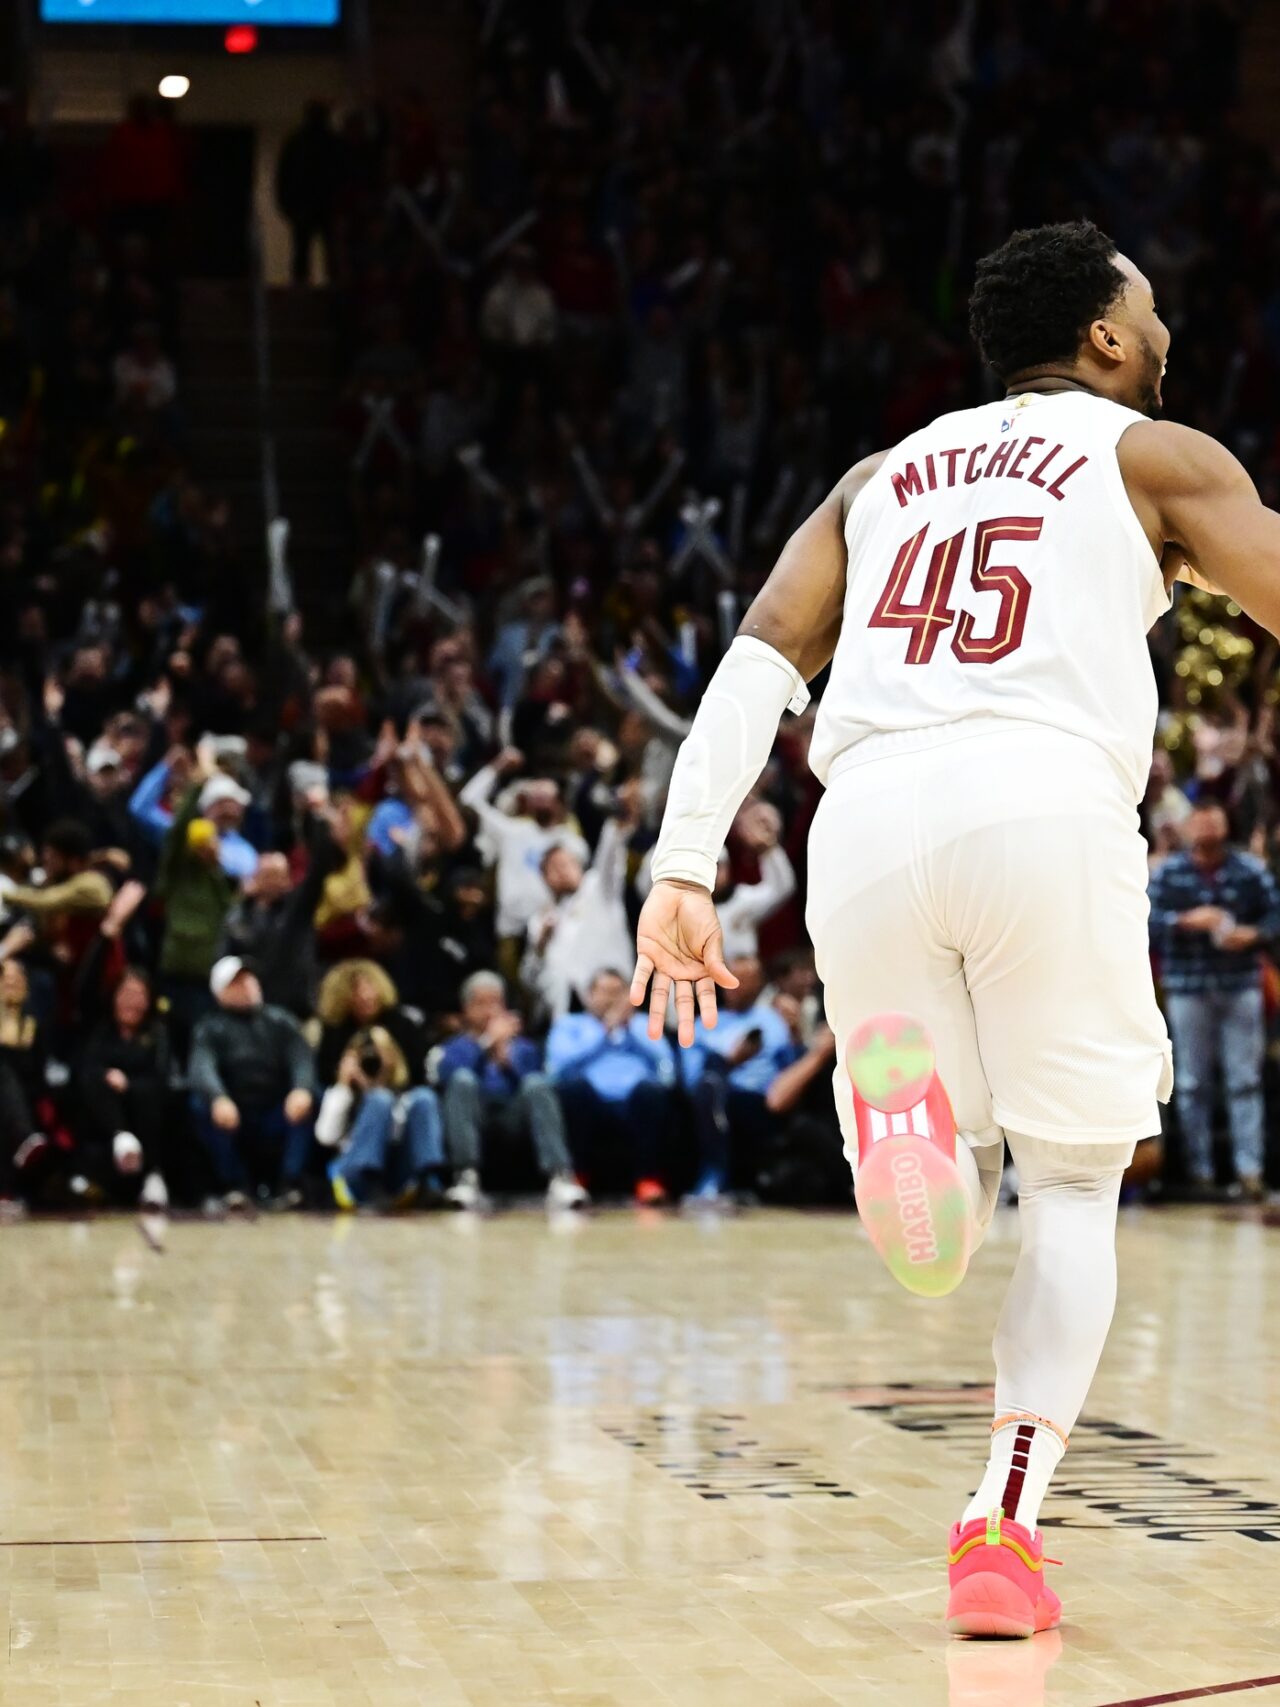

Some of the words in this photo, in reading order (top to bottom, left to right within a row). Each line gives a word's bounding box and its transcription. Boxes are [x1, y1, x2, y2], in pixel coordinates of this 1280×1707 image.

[890, 435, 1090, 508] MITCHELL
[867, 516, 1044, 664] 45
[892, 1152, 938, 1265] HARIBO
